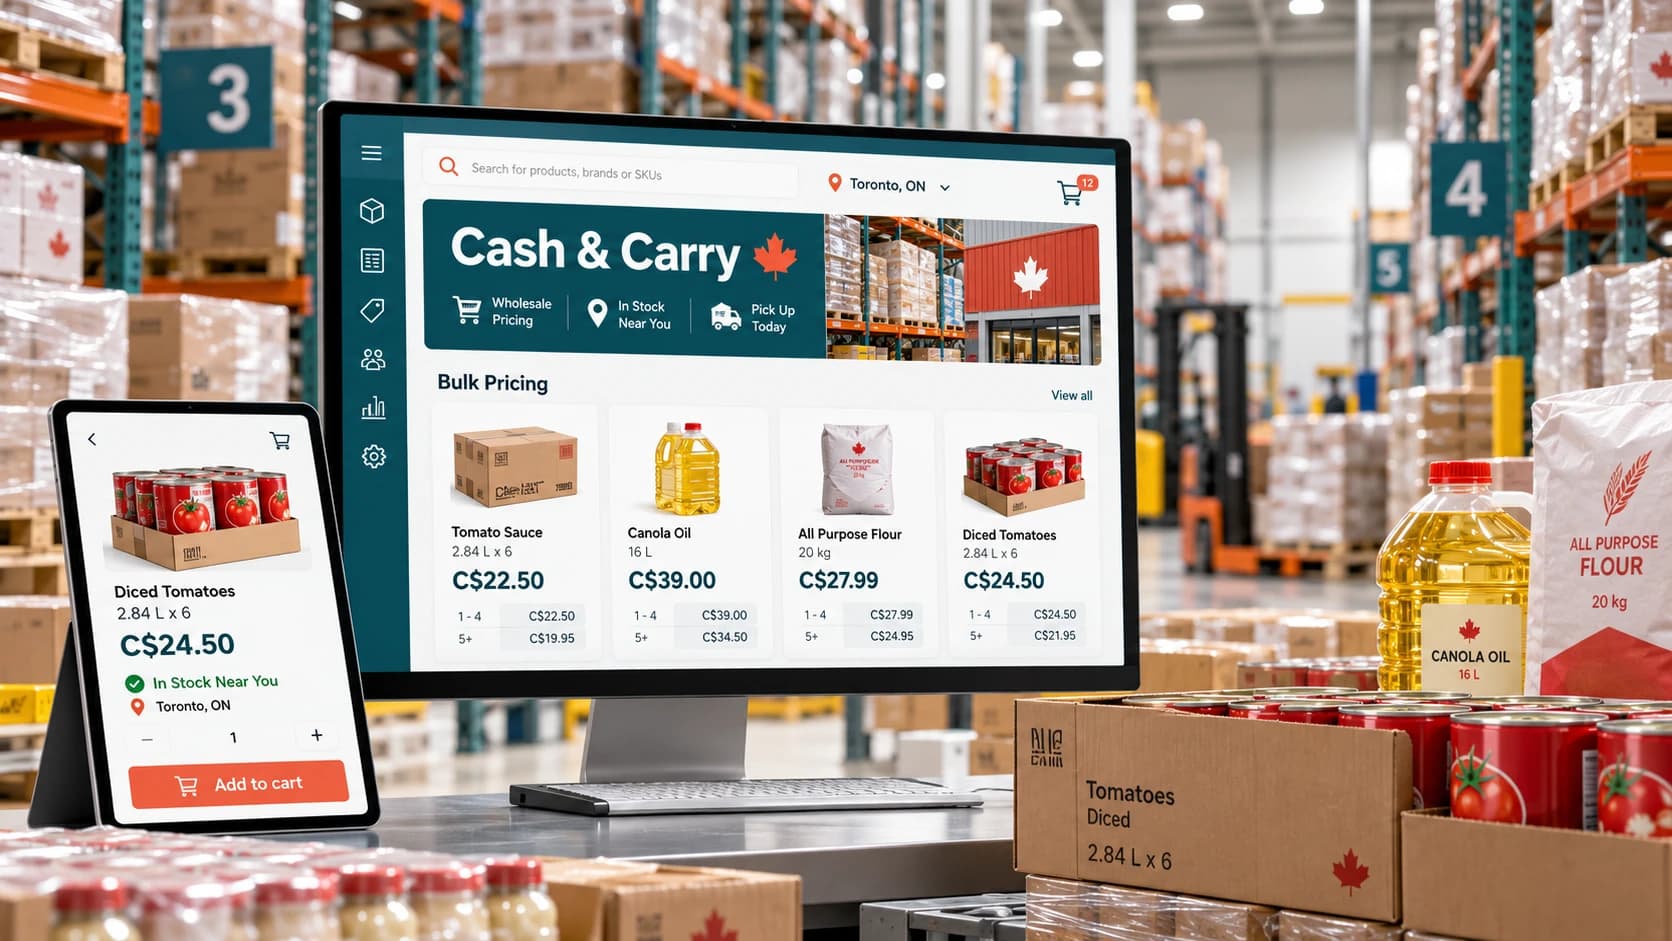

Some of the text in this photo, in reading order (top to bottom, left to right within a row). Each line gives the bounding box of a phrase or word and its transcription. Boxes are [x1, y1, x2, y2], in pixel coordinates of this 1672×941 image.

[208, 64, 249, 132] 3
[472, 163, 662, 180] Search for products, brands or SKUs
[850, 178, 925, 192] Toronto, ON
[1083, 179, 1093, 187] 12
[1446, 161, 1487, 216] 4
[452, 227, 741, 282] Cash & Carry
[1378, 250, 1401, 286] 5
[492, 297, 552, 309] Wholesale
[619, 301, 664, 312] In Stock
[752, 304, 795, 318] Pick Up
[493, 314, 533, 328] Pricing
[619, 318, 670, 329] Near You
[752, 321, 786, 334] Today
[439, 374, 547, 395] Bulk Pricing
[1052, 390, 1092, 400] View all
[451, 526, 542, 538] Tomato Sauce
[628, 527, 691, 538] Canola Oil
[799, 528, 902, 542] All Purpose Flour
[963, 529, 1056, 540] Diced Tomatoes
[1570, 535, 1658, 550] ALL PURPOSE
[452, 546, 512, 557] 2.84 L x 6
[629, 546, 652, 557] 16 L
[799, 547, 830, 560] 20 kg
[964, 548, 987, 558] 2.84
[992, 548, 998, 558] L
[1011, 548, 1017, 558] 6
[1581, 557, 1643, 576] FLOUR
[453, 569, 544, 592] C$22.50
[629, 569, 715, 591] C$39.00
[800, 569, 878, 591] C$27.99
[964, 570, 1044, 591] C$24.50
[115, 585, 235, 598] Diced Tomatoes
[1592, 594, 1627, 611] 20 kg
[117, 606, 190, 620] 2.84 L x 6
[459, 612, 462, 621] 1
[475, 612, 481, 621] 4
[529, 610, 575, 622] C$22.50
[635, 611, 638, 620] 1
[650, 611, 656, 620] 4
[702, 609, 747, 620] C$39.00
[805, 610, 808, 619] 1
[820, 610, 826, 619] 4
[871, 609, 913, 620] C$27.99
[970, 610, 973, 619] 1
[984, 610, 990, 618] 4
[1034, 609, 1076, 619] C$24.50
[459, 634, 472, 644] 5+
[530, 633, 574, 644] C$19.95
[636, 633, 647, 642] 5+
[703, 632, 747, 643] C$34.50
[806, 632, 818, 641] 5+
[871, 631, 913, 641] C$24.95
[971, 631, 982, 640] 5+
[1035, 630, 1075, 640] C$21.95
[121, 632, 234, 659] C$24.50
[1432, 650, 1510, 663] CANOLA OIL
[1460, 669, 1480, 680] 16 L
[154, 675, 278, 689] In Stock Near You
[156, 700, 230, 712] Toronto, ON
[230, 732, 236, 743] 1
[216, 777, 303, 791] Add to cart
[1086, 780, 1174, 805] Tomatoes
[1088, 808, 1130, 828] Diced
[1088, 844, 1171, 870] 2.84 L x 6
